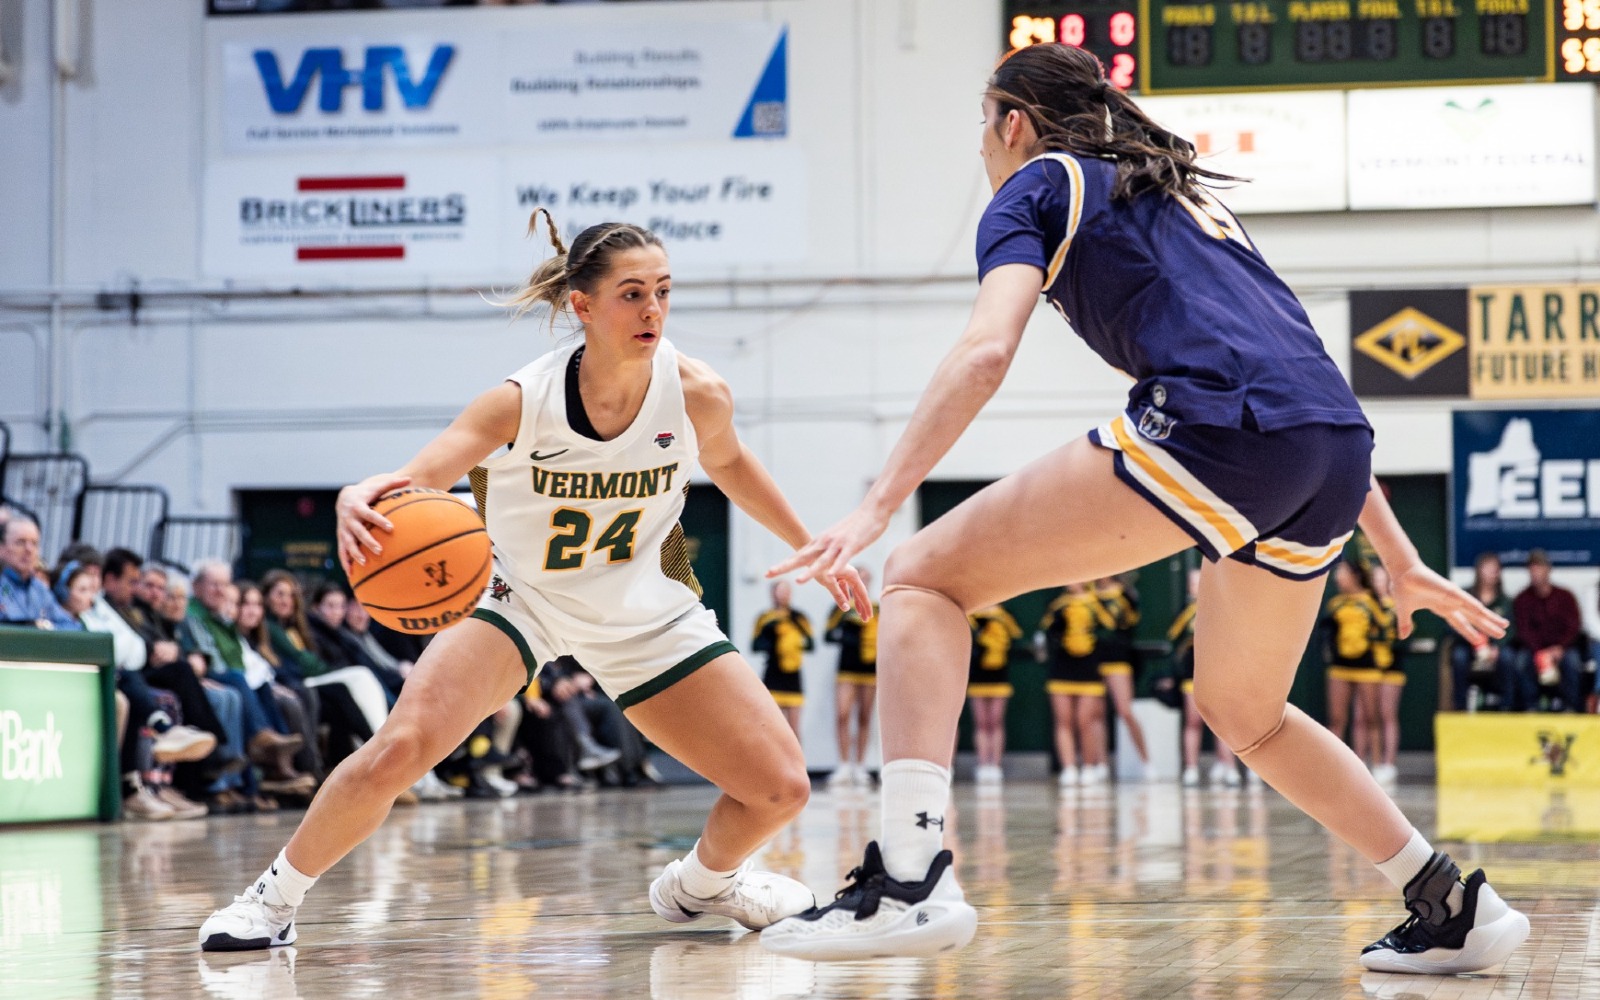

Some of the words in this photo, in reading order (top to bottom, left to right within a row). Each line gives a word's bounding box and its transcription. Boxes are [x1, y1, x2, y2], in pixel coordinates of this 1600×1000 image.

[252, 43, 456, 116] VHV
[566, 182, 640, 210] Keep
[1475, 351, 1567, 384] FUTURE
[531, 462, 679, 500] VERMONT
[542, 505, 645, 572] 24
